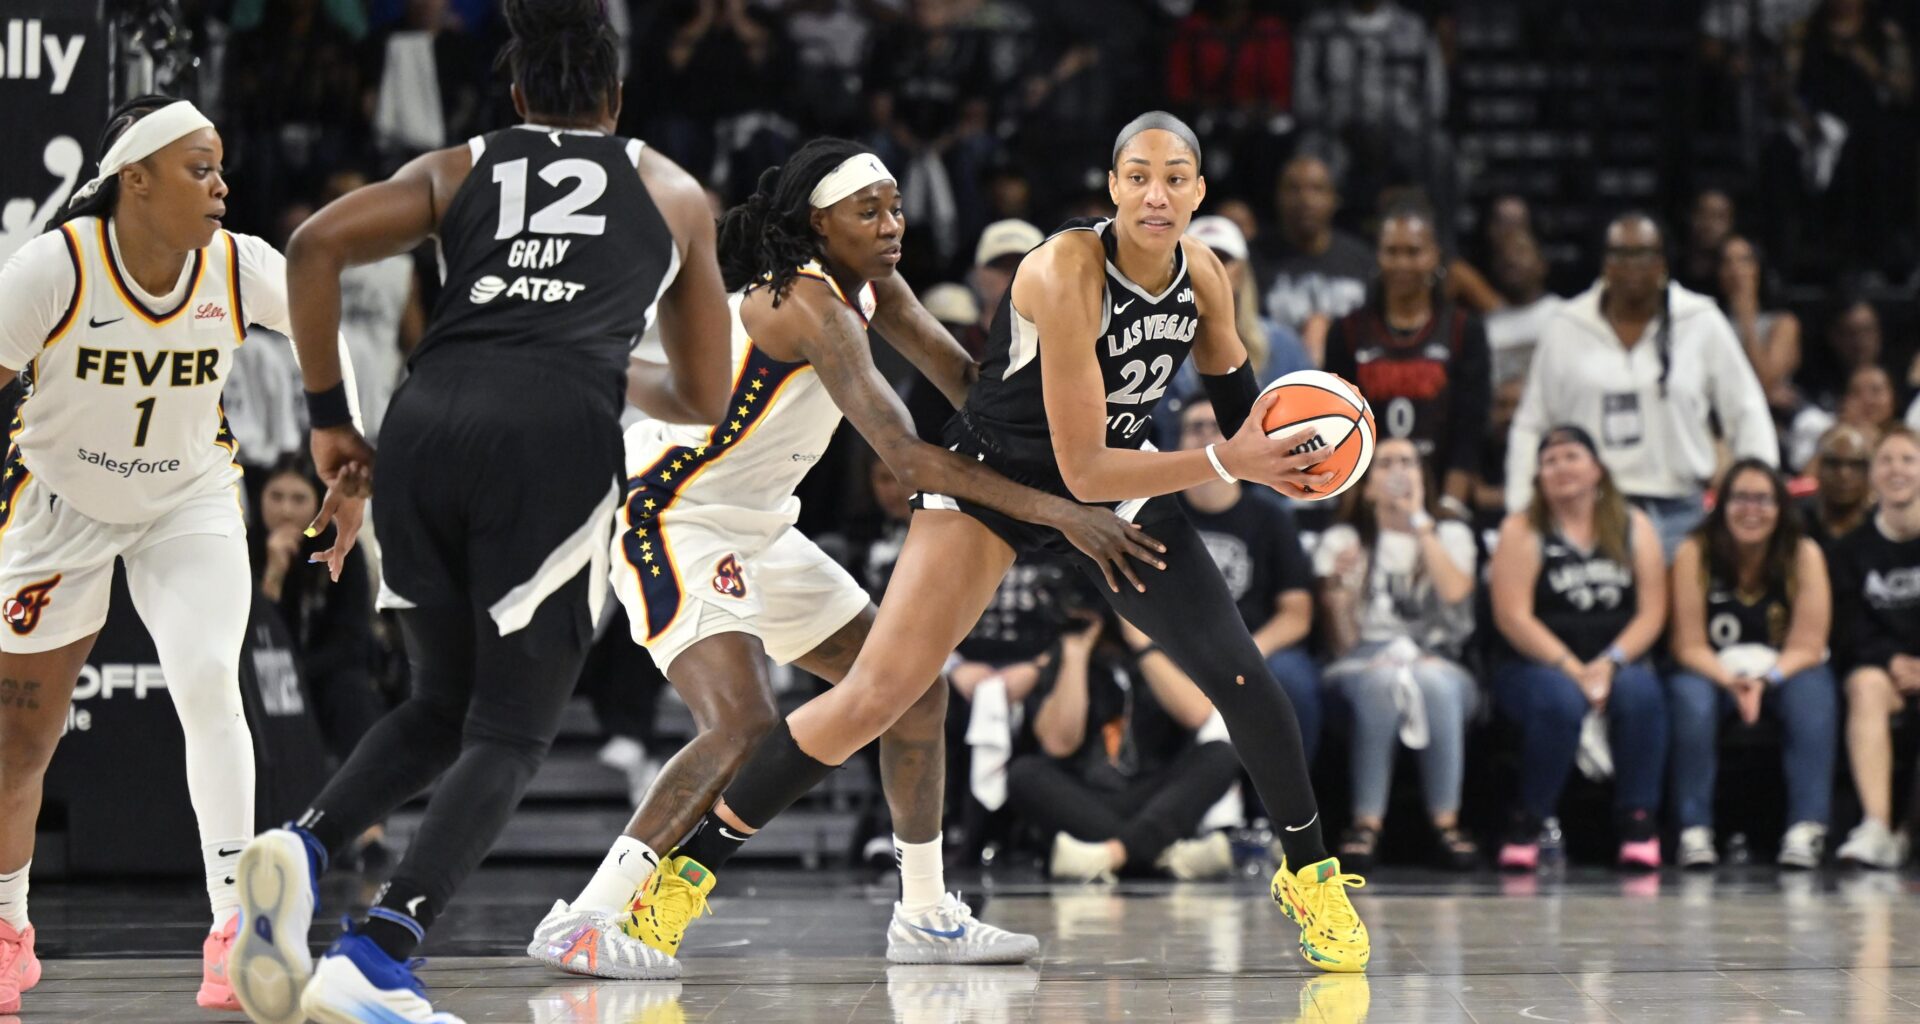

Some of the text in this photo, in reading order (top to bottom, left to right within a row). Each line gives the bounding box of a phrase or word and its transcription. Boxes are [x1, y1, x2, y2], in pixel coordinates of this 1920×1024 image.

[0, 19, 86, 94] lly
[492, 157, 608, 240] 12
[507, 238, 571, 270] GRAY
[506, 276, 586, 302] AT&T
[194, 302, 227, 321] Lilly
[1107, 313, 1198, 357] LAS VEGAS
[75, 345, 220, 387] FEVER
[1105, 354, 1173, 405] 22
[133, 396, 157, 448] 1
[77, 447, 181, 478] salesforce
[61, 703, 92, 737] le
